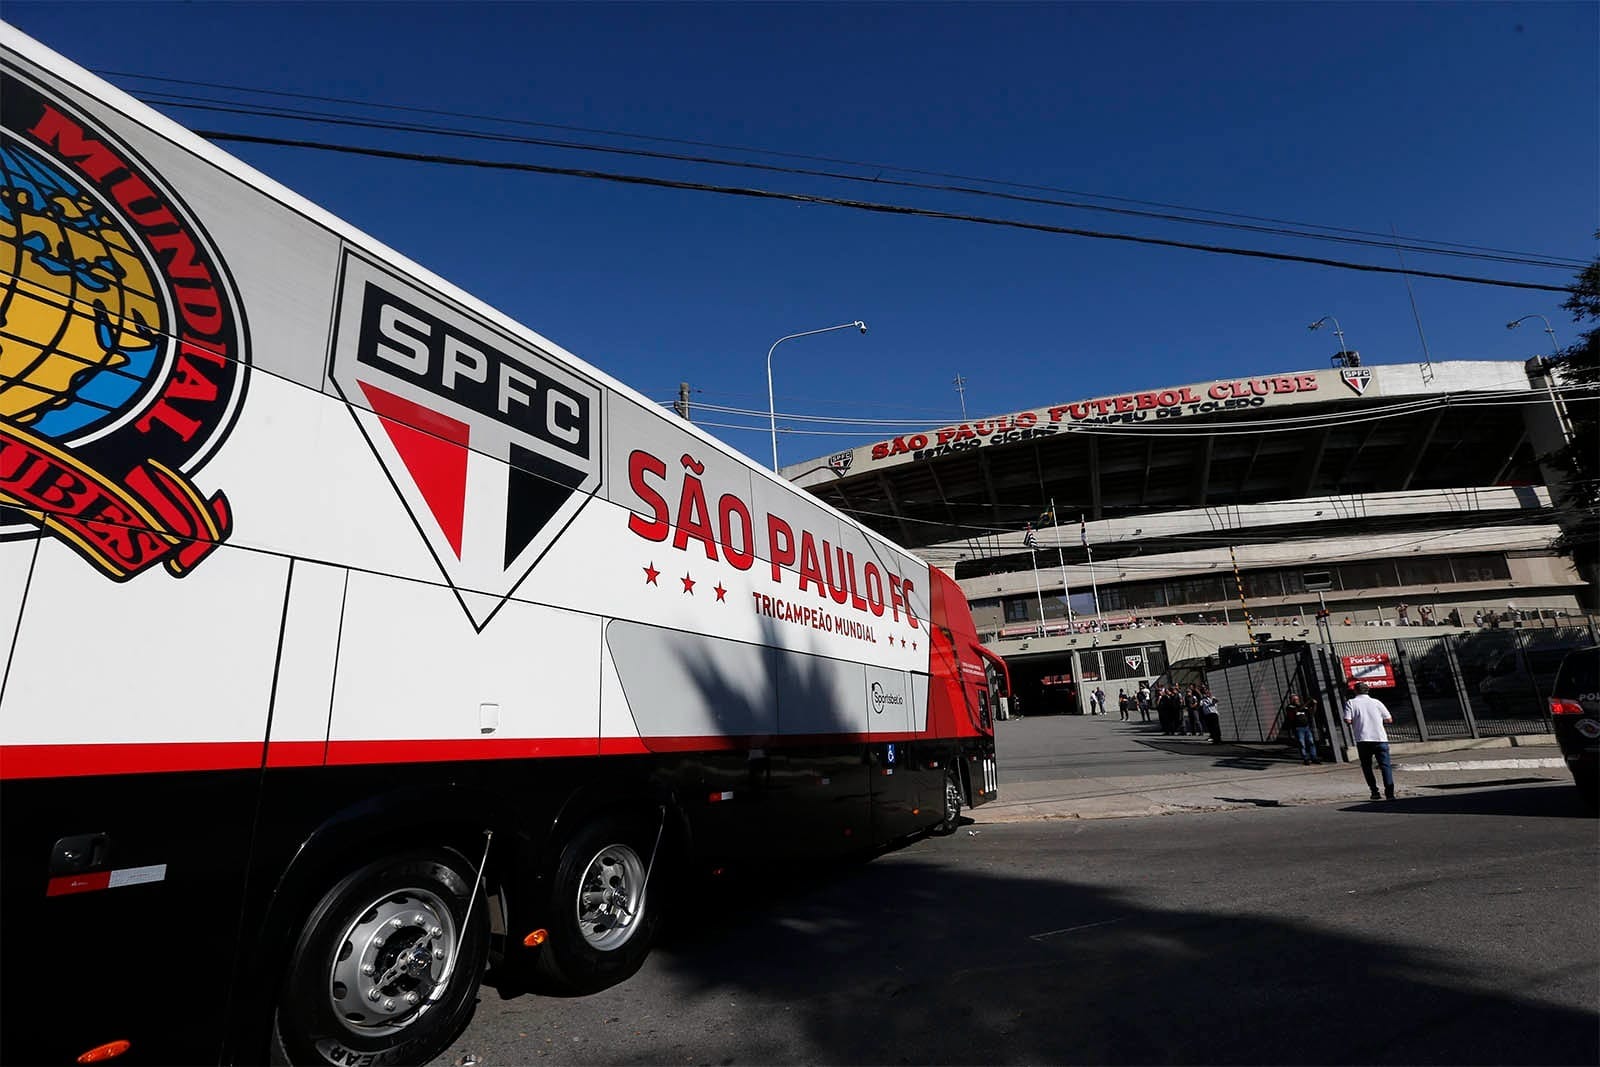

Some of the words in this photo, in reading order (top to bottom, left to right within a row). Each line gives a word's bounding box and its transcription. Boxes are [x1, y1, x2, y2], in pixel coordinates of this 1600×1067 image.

[27, 103, 227, 442] MUNDIAL
[376, 303, 581, 445] SPFC
[936, 412, 1038, 445] PAULO
[1048, 387, 1201, 422] FUTEBOL
[1208, 374, 1319, 400] CLUBE
[1156, 406, 1184, 418] DE
[1188, 396, 1265, 414] TOLEDO
[1345, 370, 1370, 378] SPFC
[628, 449, 755, 571] SÃO
[767, 512, 886, 617] PAULO
[889, 573, 919, 630] FC
[752, 591, 832, 633] TRICAMPEÃO
[834, 616, 877, 643] MUNDIAL
